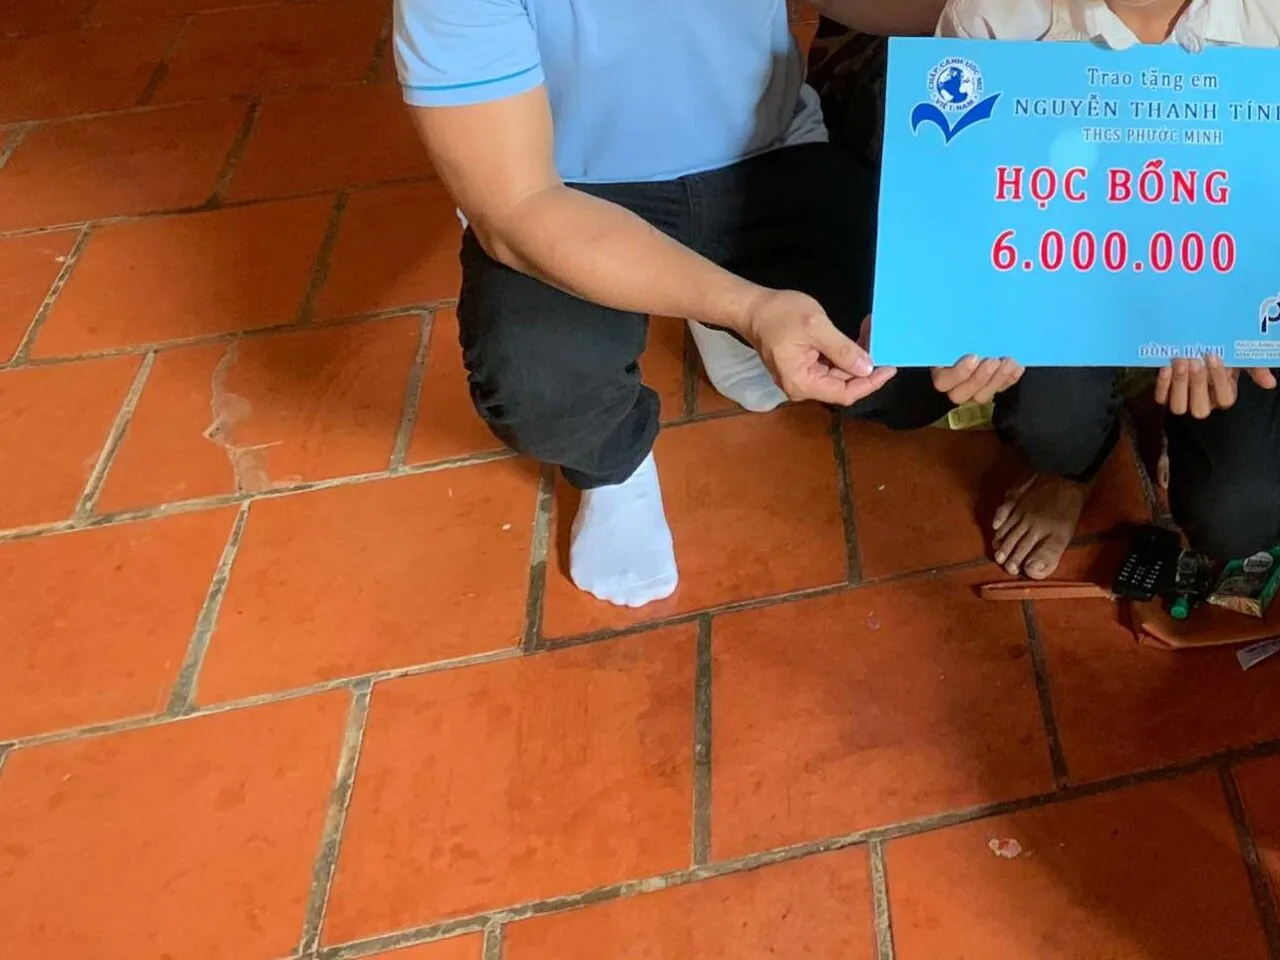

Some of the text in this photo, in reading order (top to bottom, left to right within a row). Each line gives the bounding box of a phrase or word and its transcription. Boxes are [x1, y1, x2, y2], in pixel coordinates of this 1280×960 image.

[1087, 68, 1218, 92] Trao tặng em
[1014, 94, 1118, 117] NGUYỄN
[1130, 101, 1217, 119] THANH
[1083, 125, 1222, 144] THCS PHƯỚC MINH
[995, 167, 1087, 209] HỌC
[991, 230, 1236, 272] 6.000.000
